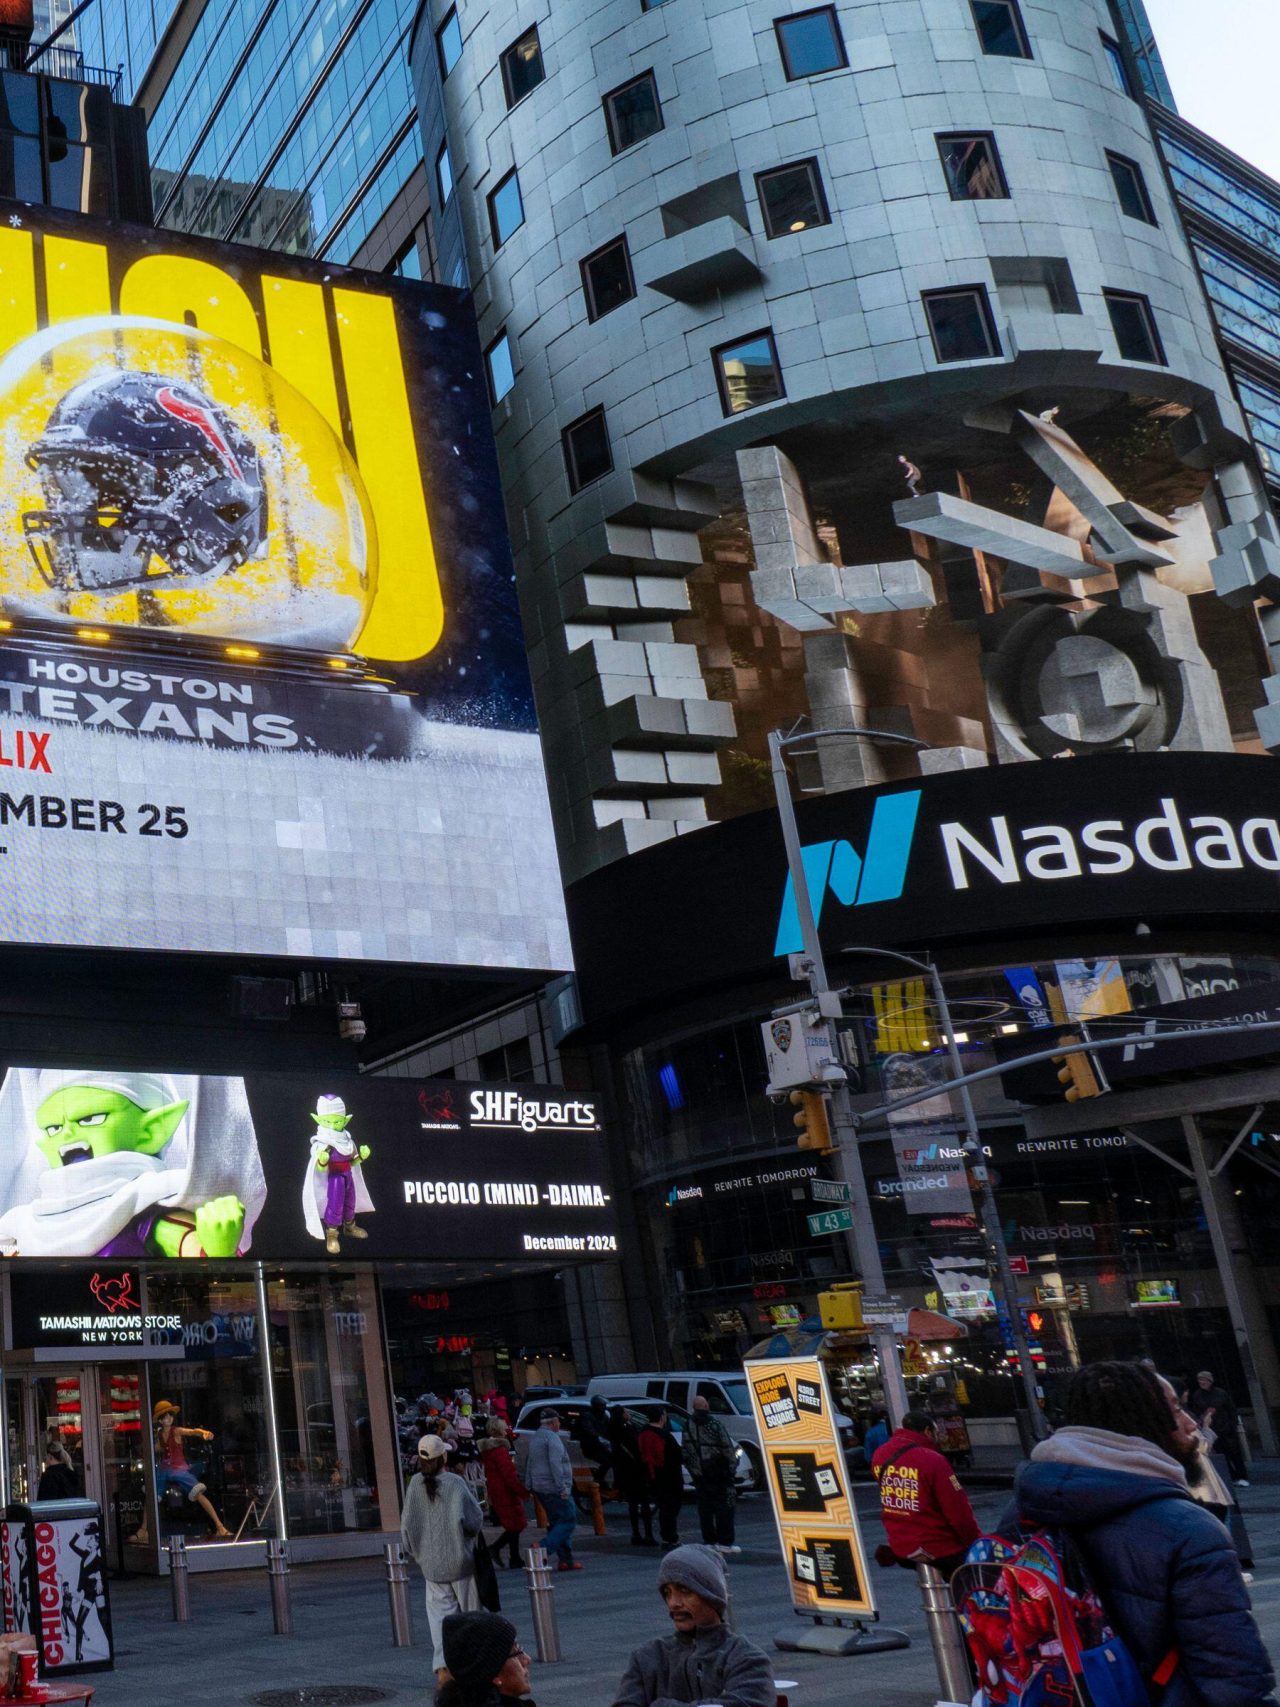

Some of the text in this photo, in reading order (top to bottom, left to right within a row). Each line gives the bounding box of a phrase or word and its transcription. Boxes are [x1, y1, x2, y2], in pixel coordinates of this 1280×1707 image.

[27, 658, 253, 705] HOUSTON
[137, 803, 189, 839] 25
[940, 1146, 992, 1159] Nasq
[1017, 1139, 1078, 1153] REWRITE
[714, 1167, 818, 1192] REWRITE TOMORROW
[878, 1175, 949, 1194] branded
[403, 1181, 611, 1206] PICCOLO (MINI) -DAIMA-
[676, 1186, 703, 1200] Nasdaq
[812, 1181, 846, 1201] BROADWAY
[810, 1211, 851, 1233] W 43 ST
[523, 1234, 617, 1251] December 2024
[40, 1315, 182, 1330] TAMASHII NATIONS STORE
[82, 1331, 143, 1342] NEW YORK
[755, 1375, 787, 1393] EXPLORE
[759, 1390, 780, 1405] MORE
[798, 1393, 820, 1407] STREET
[770, 1398, 794, 1414] TIMES
[766, 1409, 797, 1427] SQUARE
[874, 1465, 918, 1480] HP-ON
[882, 1477, 919, 1490] SCOVER
[881, 1486, 918, 1500] OP-OFF
[881, 1496, 920, 1512] XPLORE
[0, 1522, 15, 1634] HICAGO
[34, 1522, 64, 1665] CHICAGO
